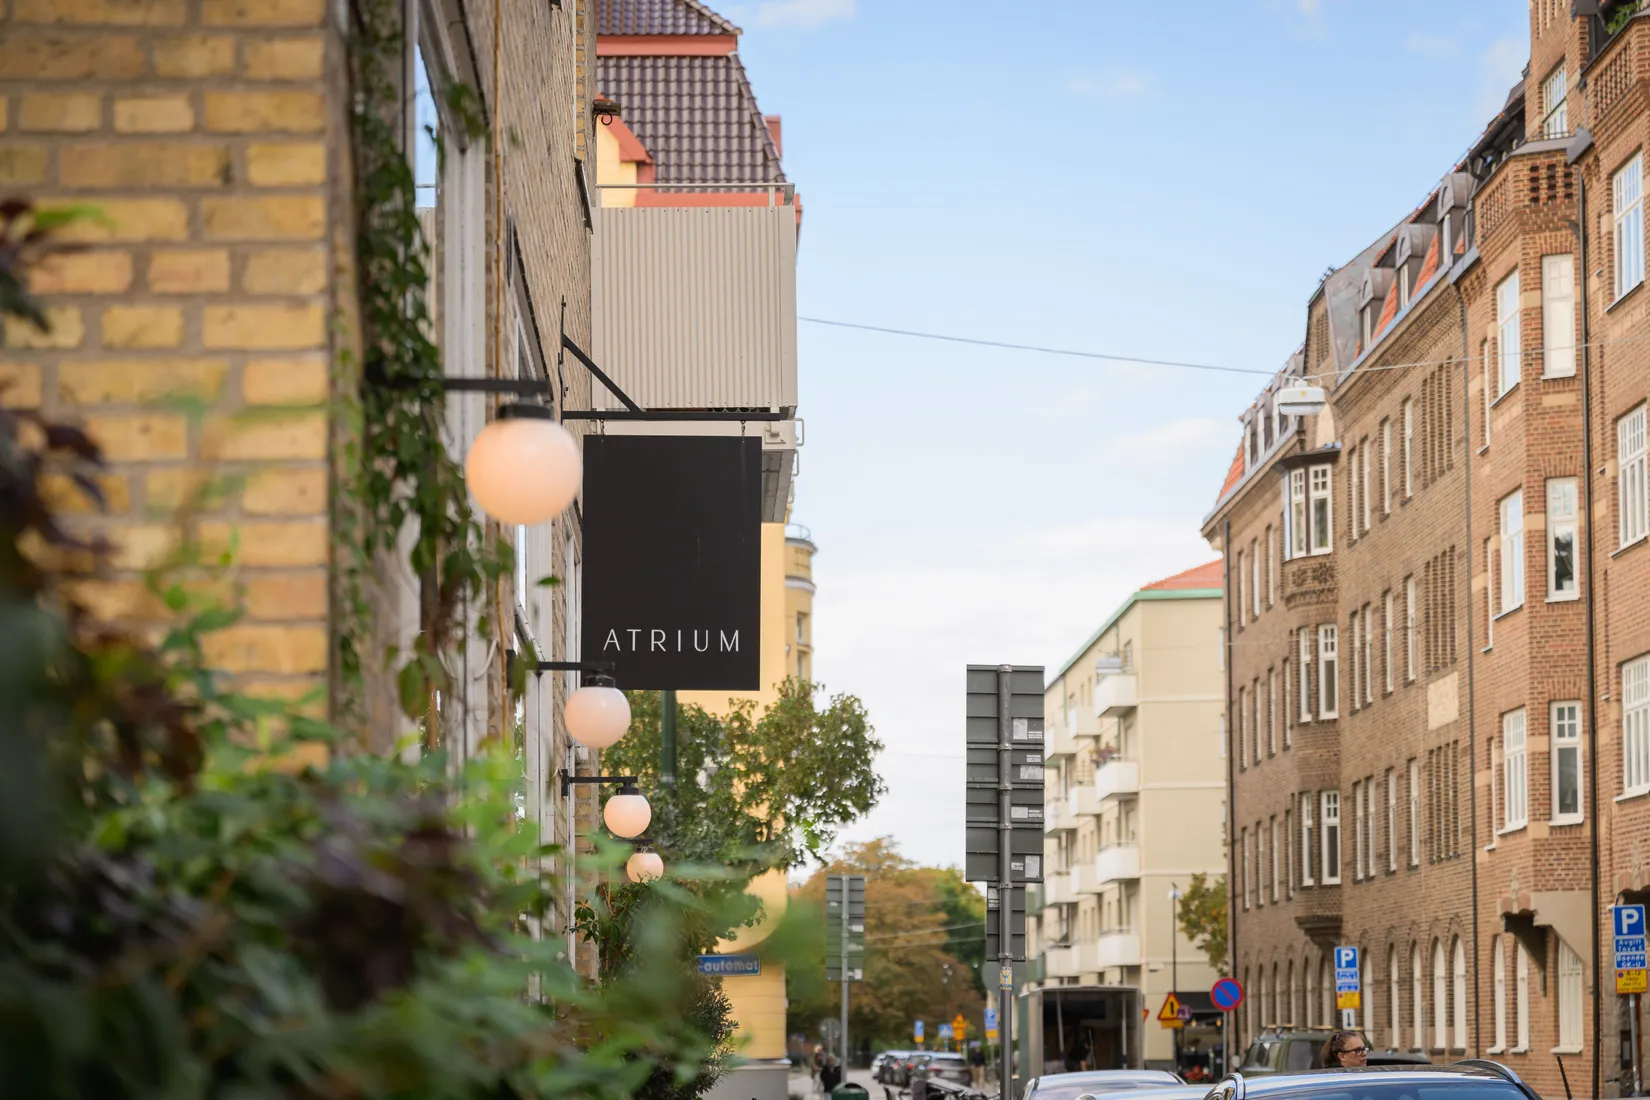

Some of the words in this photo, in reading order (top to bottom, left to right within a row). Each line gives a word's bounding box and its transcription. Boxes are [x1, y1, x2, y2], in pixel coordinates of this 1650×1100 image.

[603, 628, 739, 652] ATRIUM
[1621, 908, 1639, 934] P
[698, 960, 758, 972] -automat
[1341, 949, 1354, 968] P
